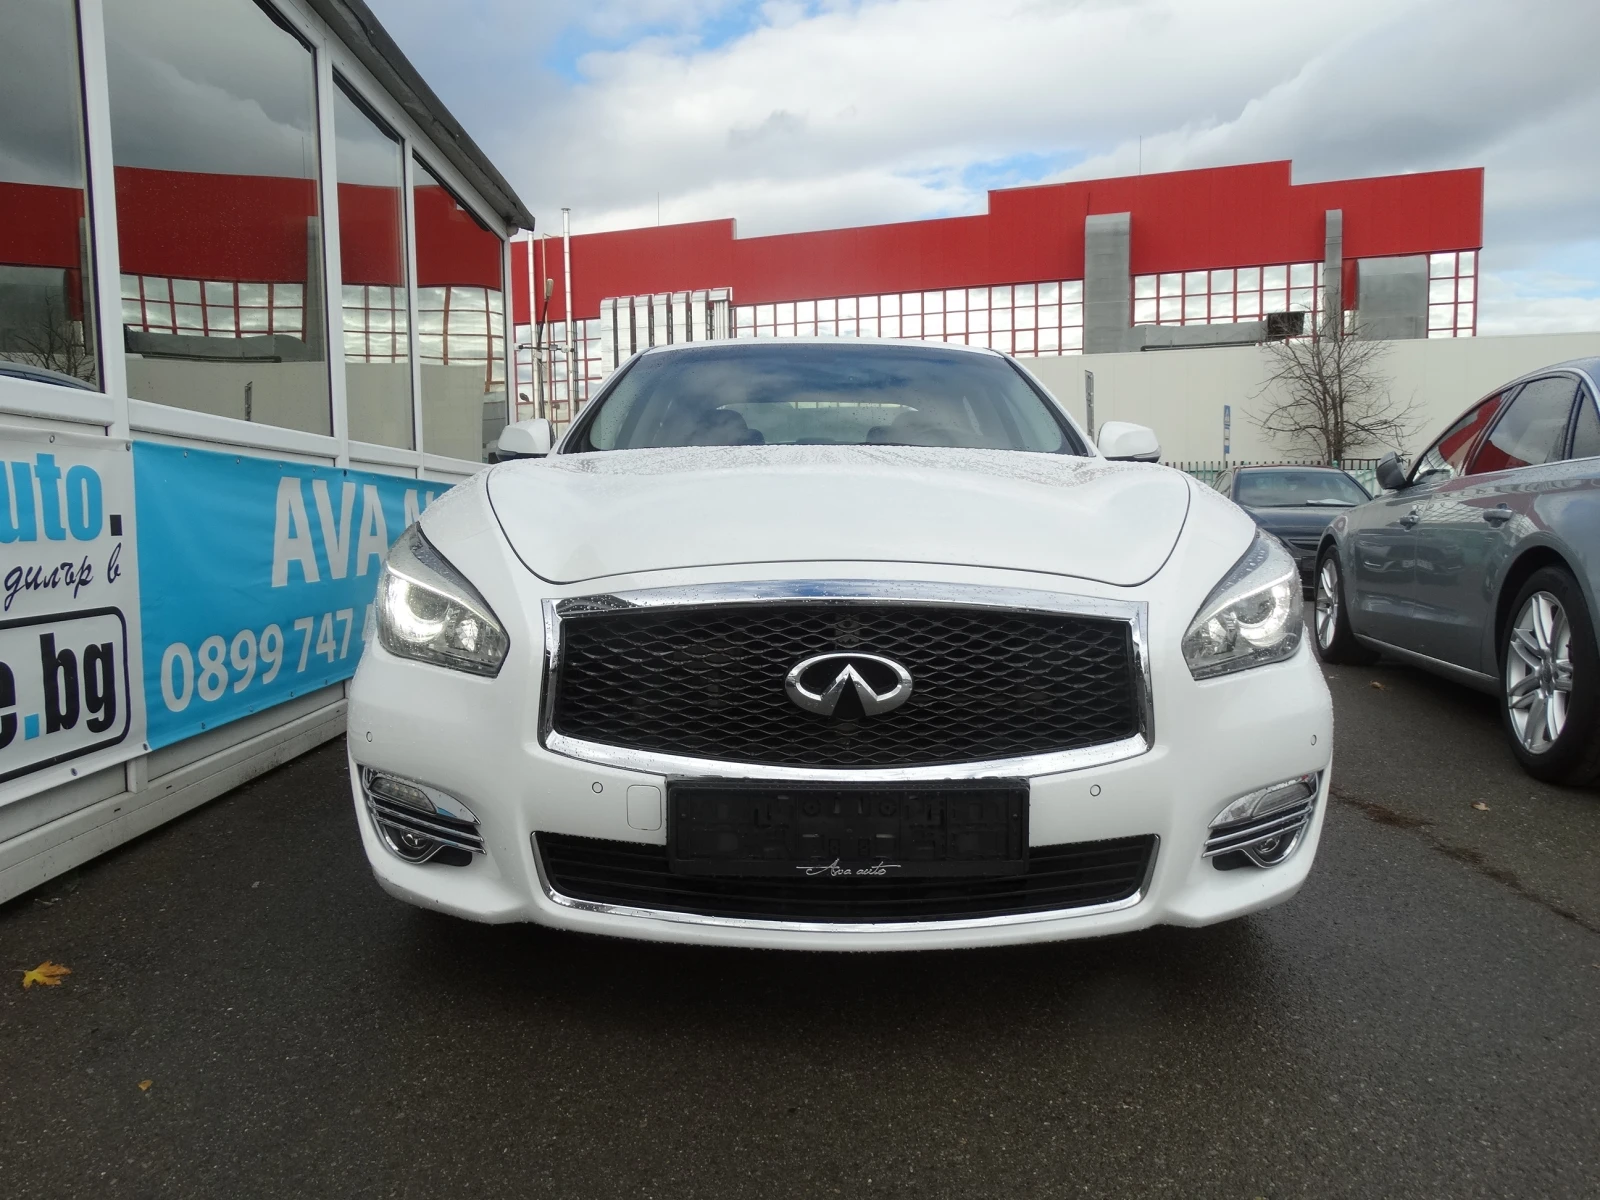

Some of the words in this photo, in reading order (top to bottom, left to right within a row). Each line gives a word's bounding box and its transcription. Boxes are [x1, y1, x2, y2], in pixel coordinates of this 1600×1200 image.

[272, 476, 389, 588] AVA
[4, 555, 94, 612] дилър
[160, 623, 284, 713] 0899
[294, 608, 353, 673] 747
[796, 858, 852, 876] Ava
[856, 861, 901, 876] auto
